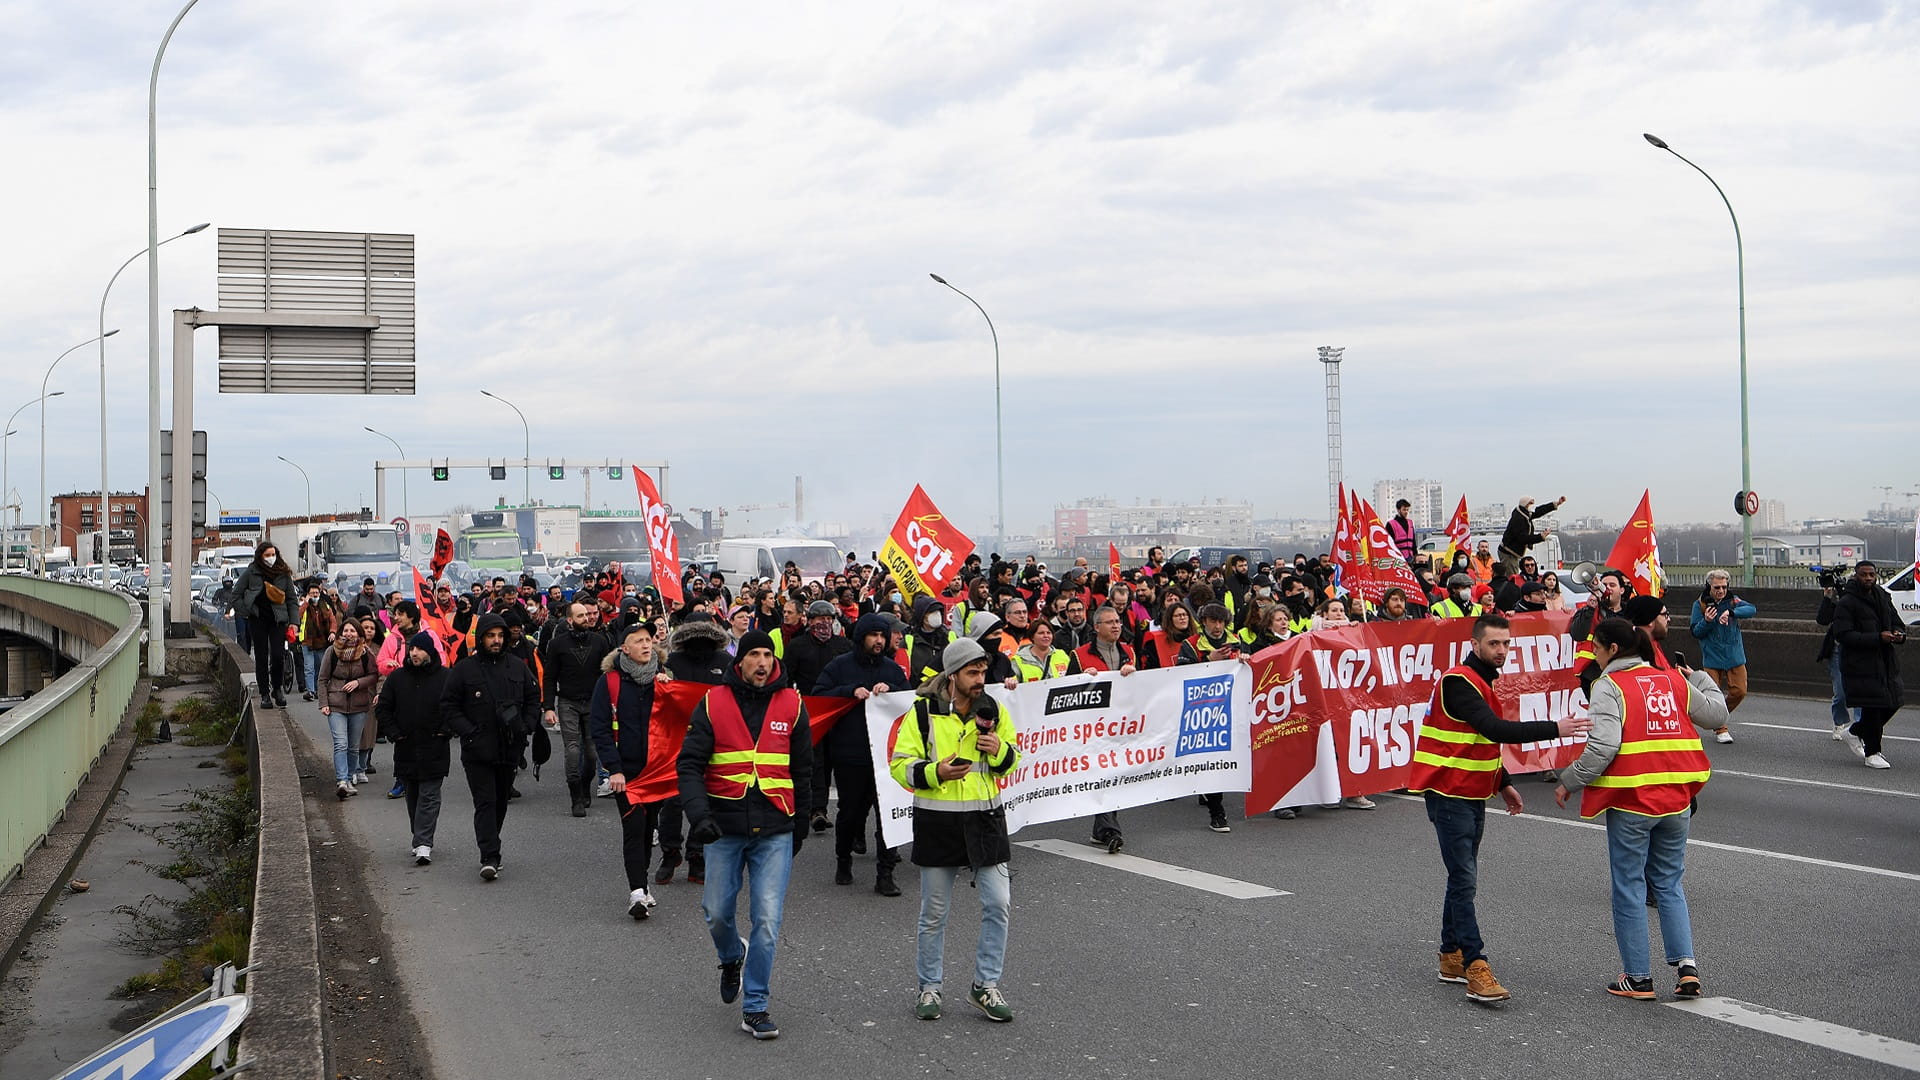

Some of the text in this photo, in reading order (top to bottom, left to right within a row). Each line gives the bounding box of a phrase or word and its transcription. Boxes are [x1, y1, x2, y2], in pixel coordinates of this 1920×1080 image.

[395, 523, 406, 531] 70
[906, 521, 953, 581] cgt
[892, 556, 908, 576] CGT
[1051, 690, 1103, 710] RETRAITES
[1187, 681, 1232, 701] EDF-GDF
[1250, 668, 1307, 725] cgt
[1647, 691, 1678, 717] cgt
[770, 721, 788, 732] CGT
[1184, 705, 1228, 732] 100%
[1648, 720, 1662, 730] UL
[1016, 714, 1146, 754] Régime spécial
[1180, 730, 1228, 752] PUBLIC
[1034, 754, 1090, 779] toutes
[1098, 750, 1119, 768] et
[1125, 746, 1166, 766] tous
[892, 806, 914, 820] Elarg
[1026, 786, 1061, 803] spéciaux
[1062, 783, 1073, 795] de
[1074, 777, 1111, 793] retraite
[1163, 766, 1173, 777] de
[1175, 765, 1182, 775] la
[1184, 760, 1238, 776] population
